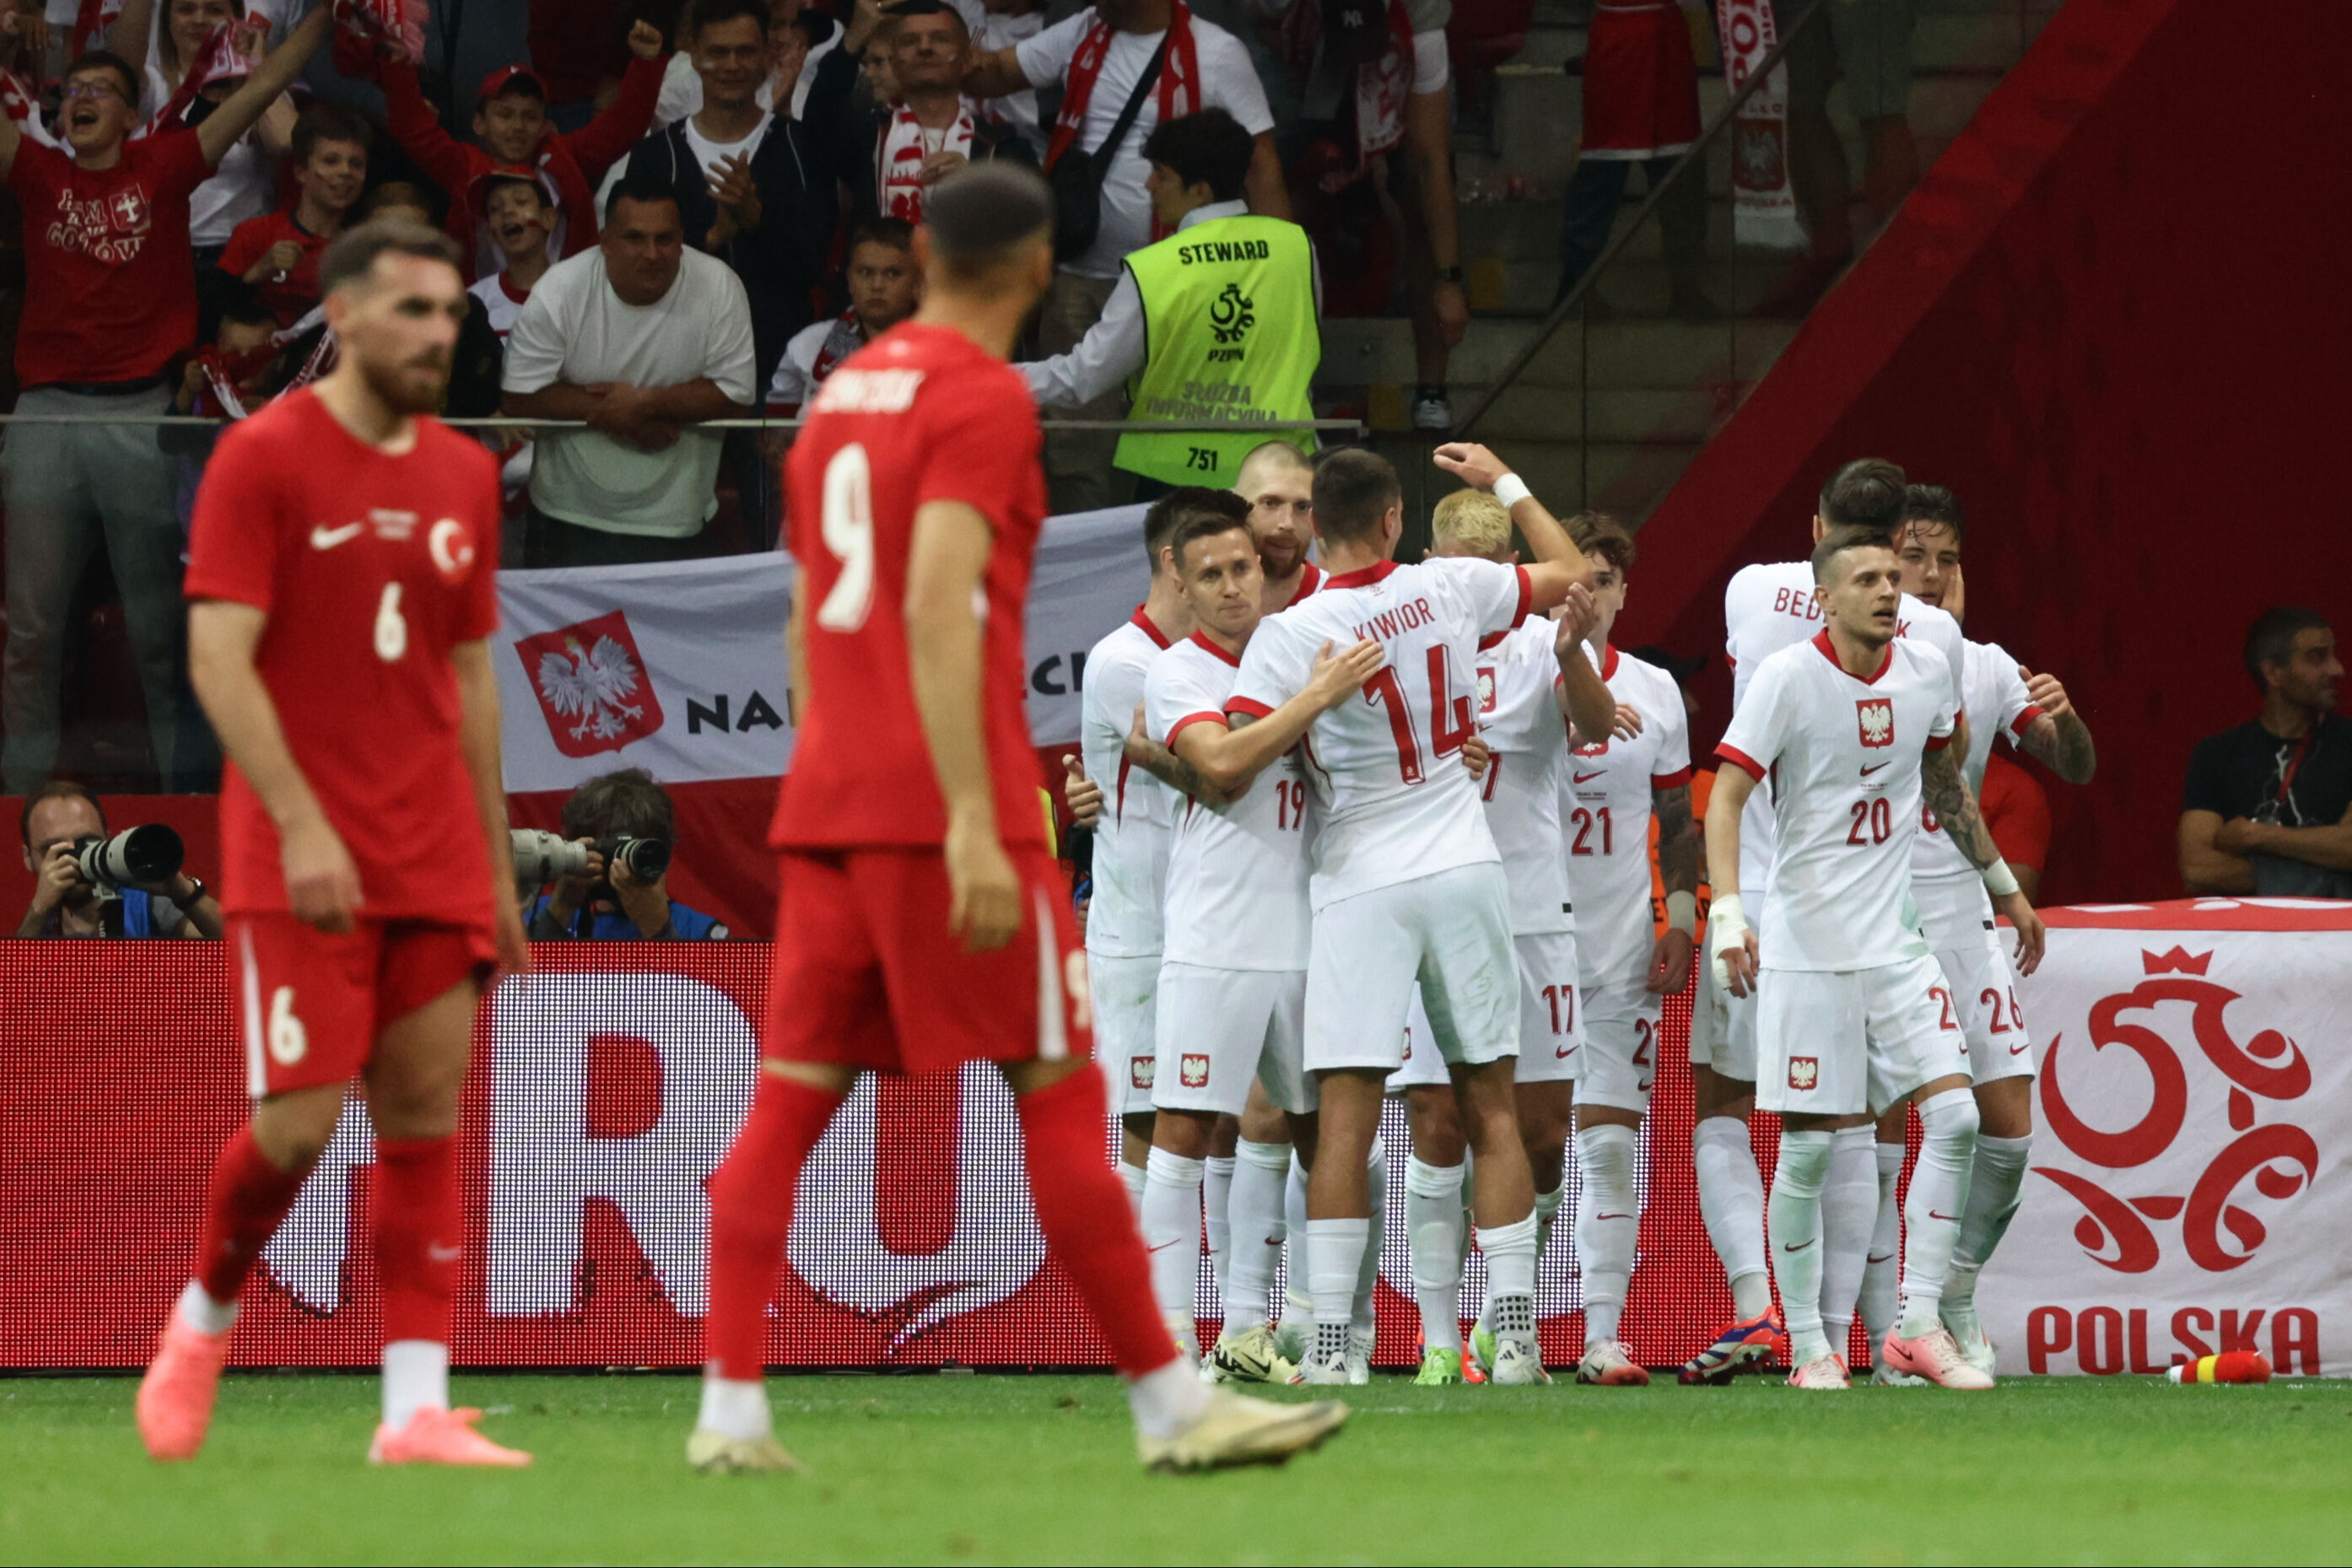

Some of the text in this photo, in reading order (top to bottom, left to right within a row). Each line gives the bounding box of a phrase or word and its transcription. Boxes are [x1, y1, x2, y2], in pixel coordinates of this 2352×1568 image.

[1178, 240, 1270, 265] STEWARD
[1207, 348, 1244, 362] PZPN
[1186, 447, 1218, 471] 751
[817, 441, 875, 633] 9
[373, 581, 407, 661] 6
[1352, 597, 1435, 644] KIWIOR
[686, 690, 795, 734] NA
[1362, 643, 1475, 785] 14
[1276, 779, 1306, 831] 19
[1847, 798, 1892, 846] 20
[1571, 806, 1612, 856] 21
[268, 986, 308, 1065] 6
[1541, 985, 1573, 1035] 17
[1929, 987, 1961, 1032] 2
[1980, 985, 2025, 1036] 26
[2026, 1305, 2321, 1377] POLSKA
